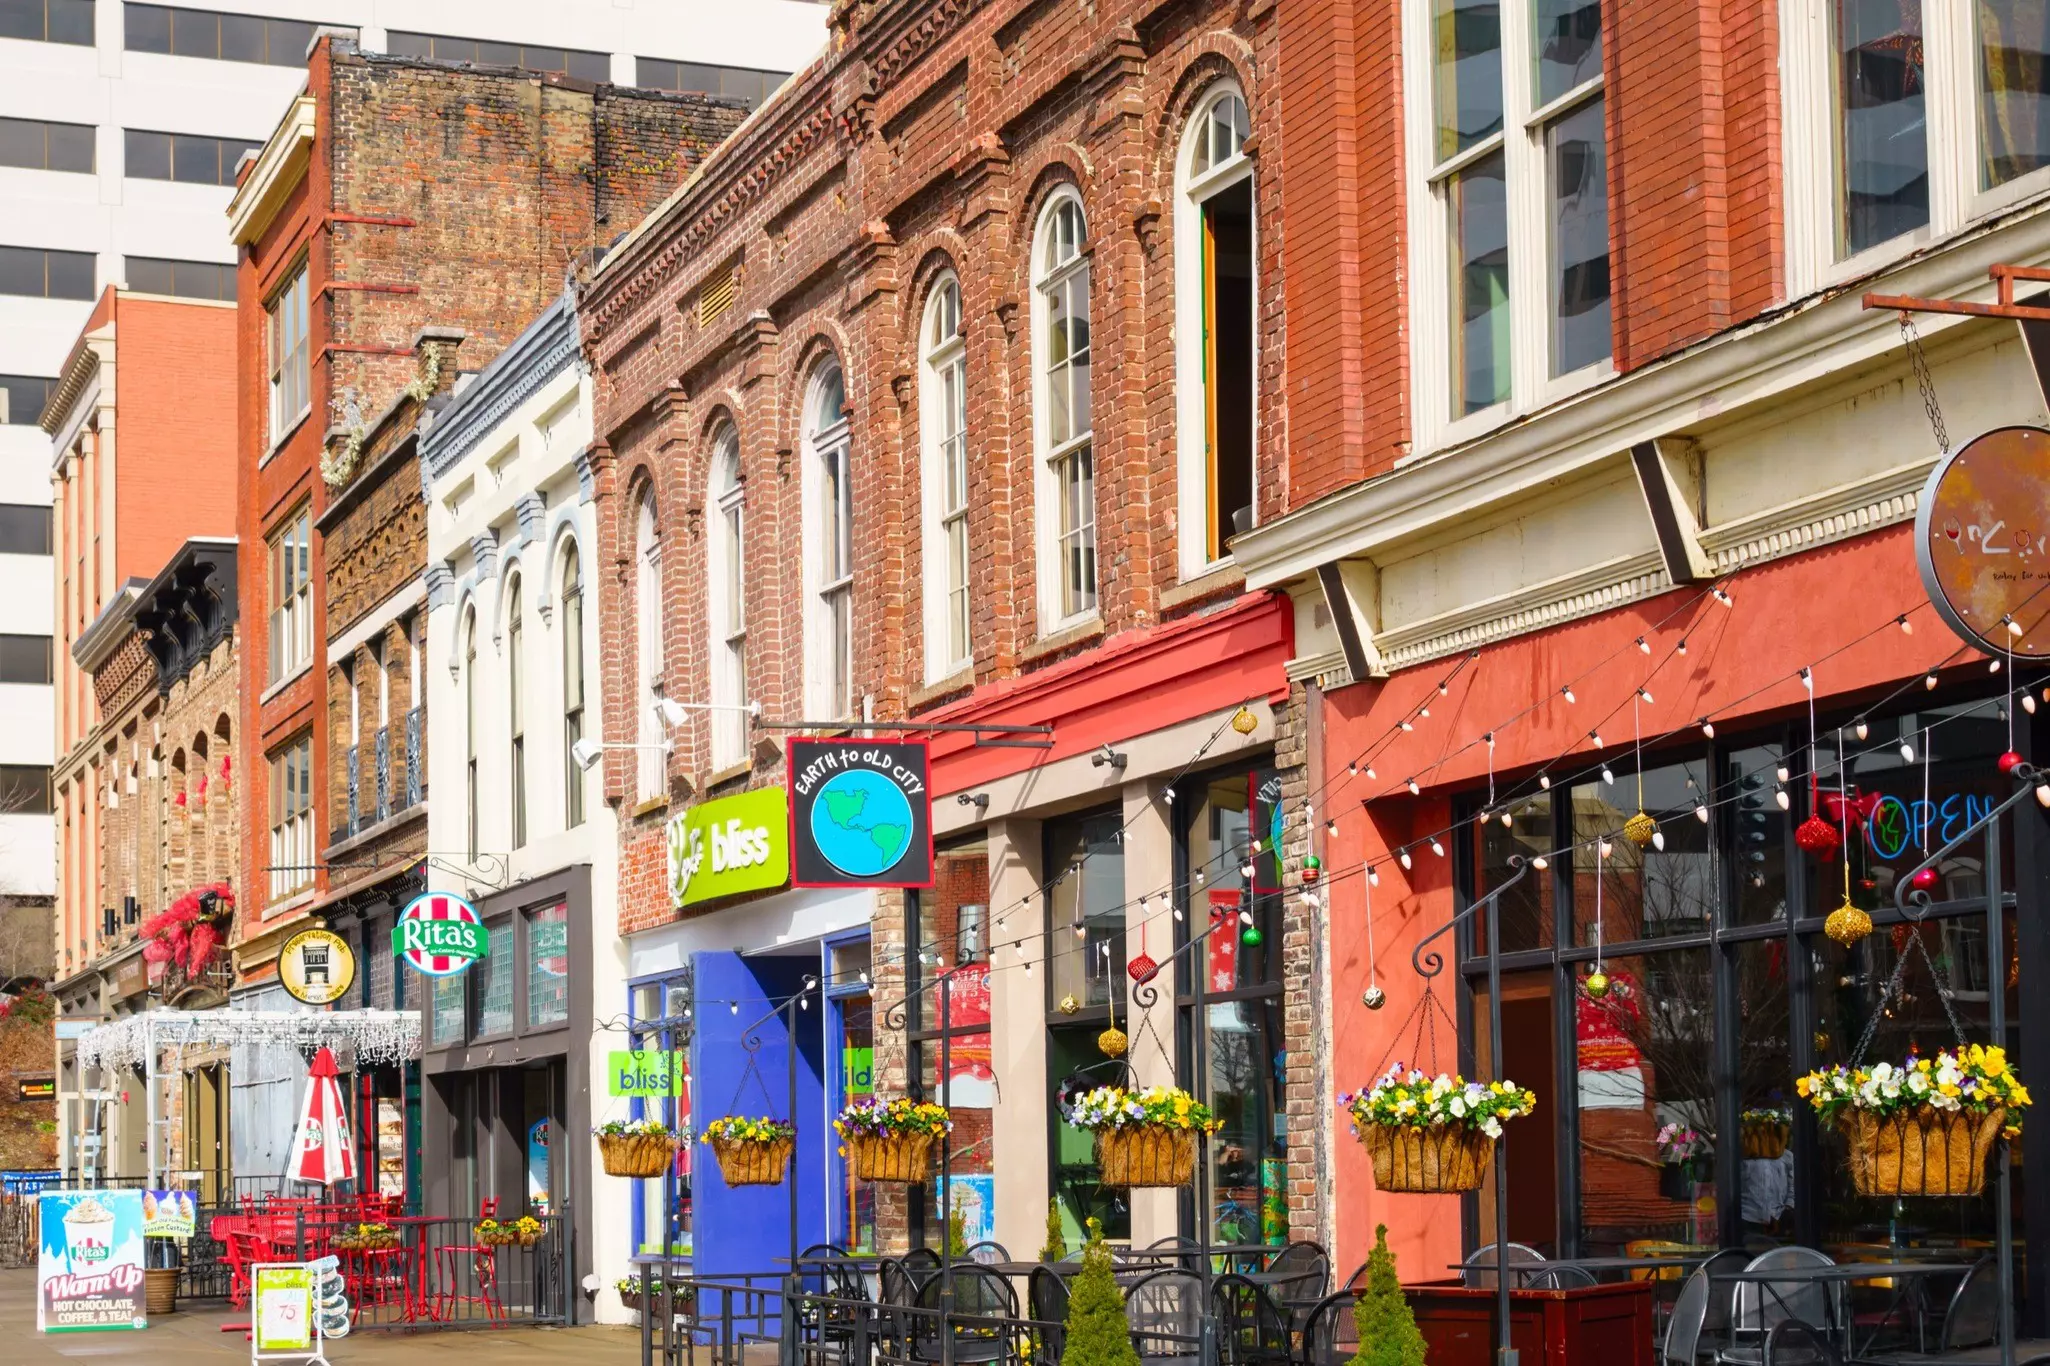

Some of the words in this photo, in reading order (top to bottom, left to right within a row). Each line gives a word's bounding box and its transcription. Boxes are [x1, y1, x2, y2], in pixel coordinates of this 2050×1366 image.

[795, 750, 839, 796] EARTH
[839, 748, 859, 769] to
[892, 766, 925, 795] CITY
[1869, 794, 1995, 860] OPEN
[711, 818, 769, 873] bliss
[285, 930, 332, 955] Preservation
[333, 939, 347, 954] Pub
[403, 918, 477, 951] Rita's
[619, 1068, 669, 1090] bliss
[45, 1274, 111, 1300] Warm
[110, 1263, 144, 1293] Up
[53, 1300, 75, 1312] HOT
[75, 1299, 137, 1311] CHOCOLATE,
[58, 1312, 98, 1325] COFFEE,
[98, 1313, 108, 1322] &
[108, 1311, 132, 1322] TEA!
